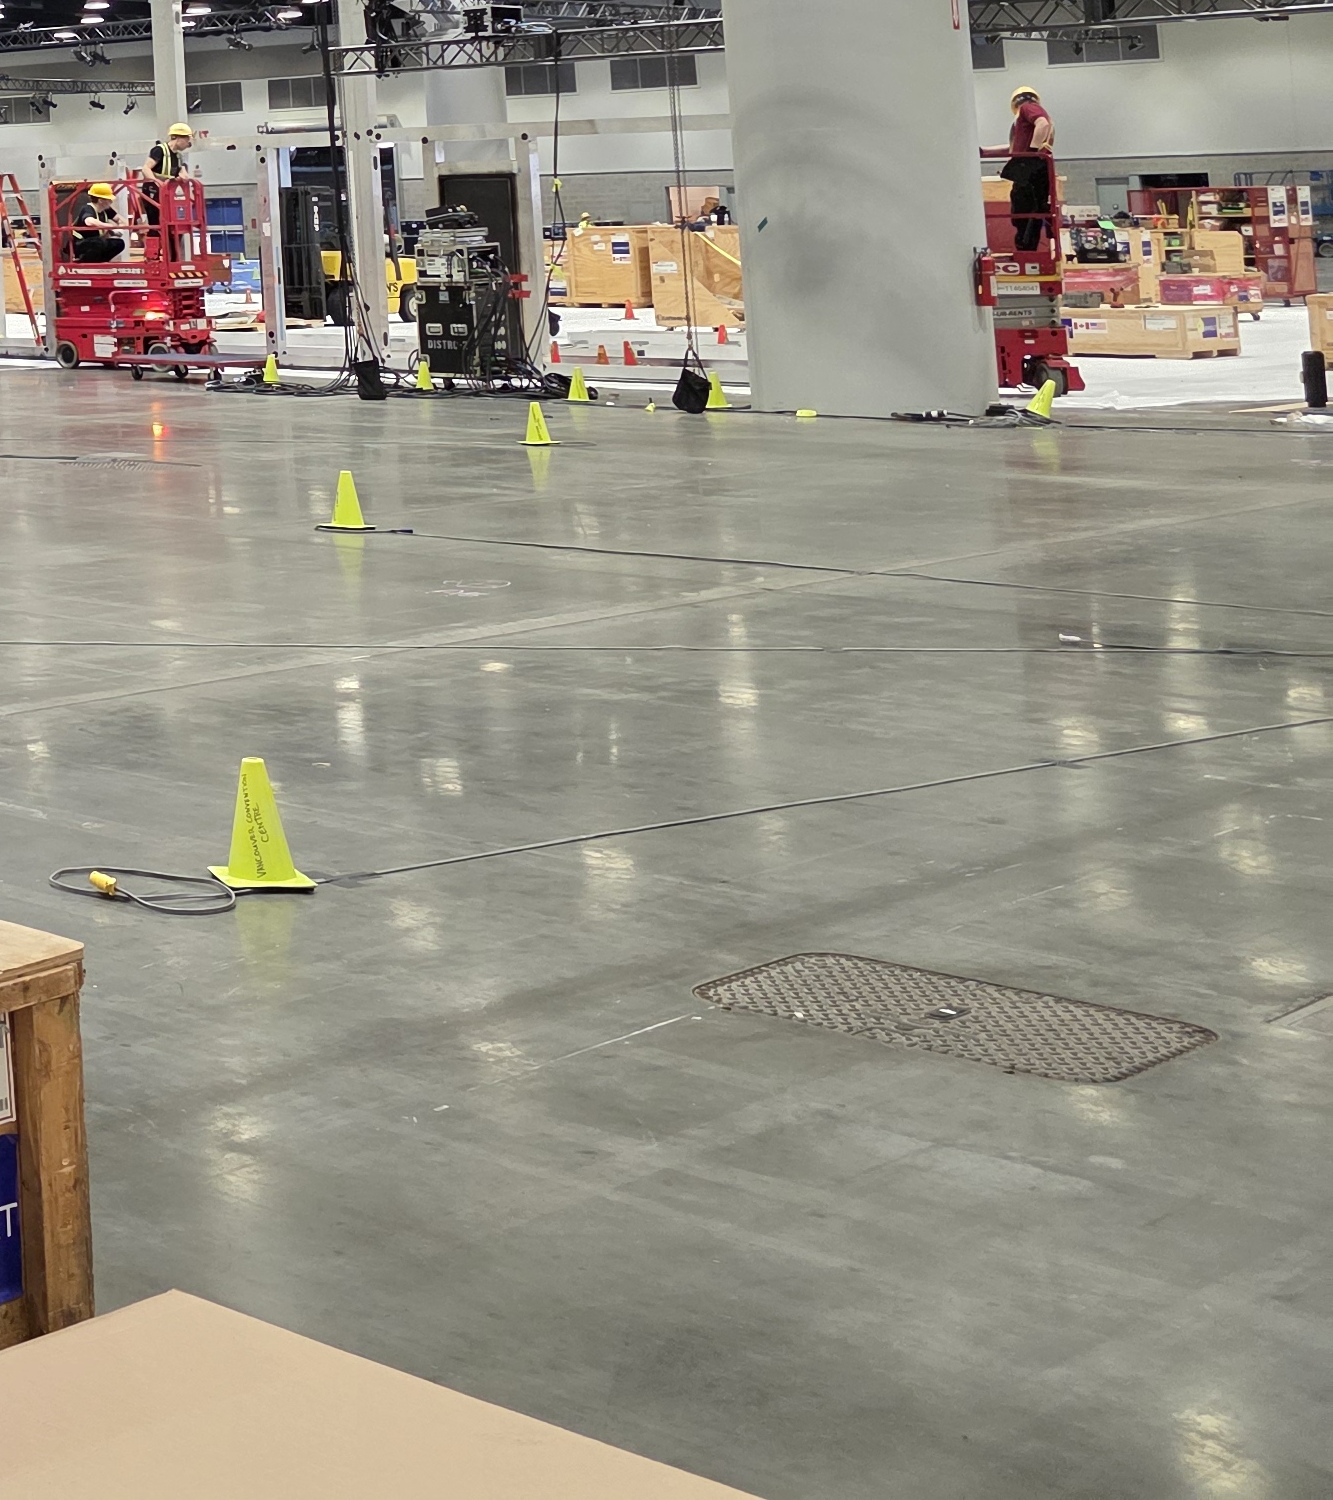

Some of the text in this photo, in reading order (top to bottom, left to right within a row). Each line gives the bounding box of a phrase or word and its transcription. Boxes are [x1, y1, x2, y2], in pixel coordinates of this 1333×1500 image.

[241, 773, 267, 879] VANCOUVER CONVENTION
[252, 802, 269, 843] CENTRE
